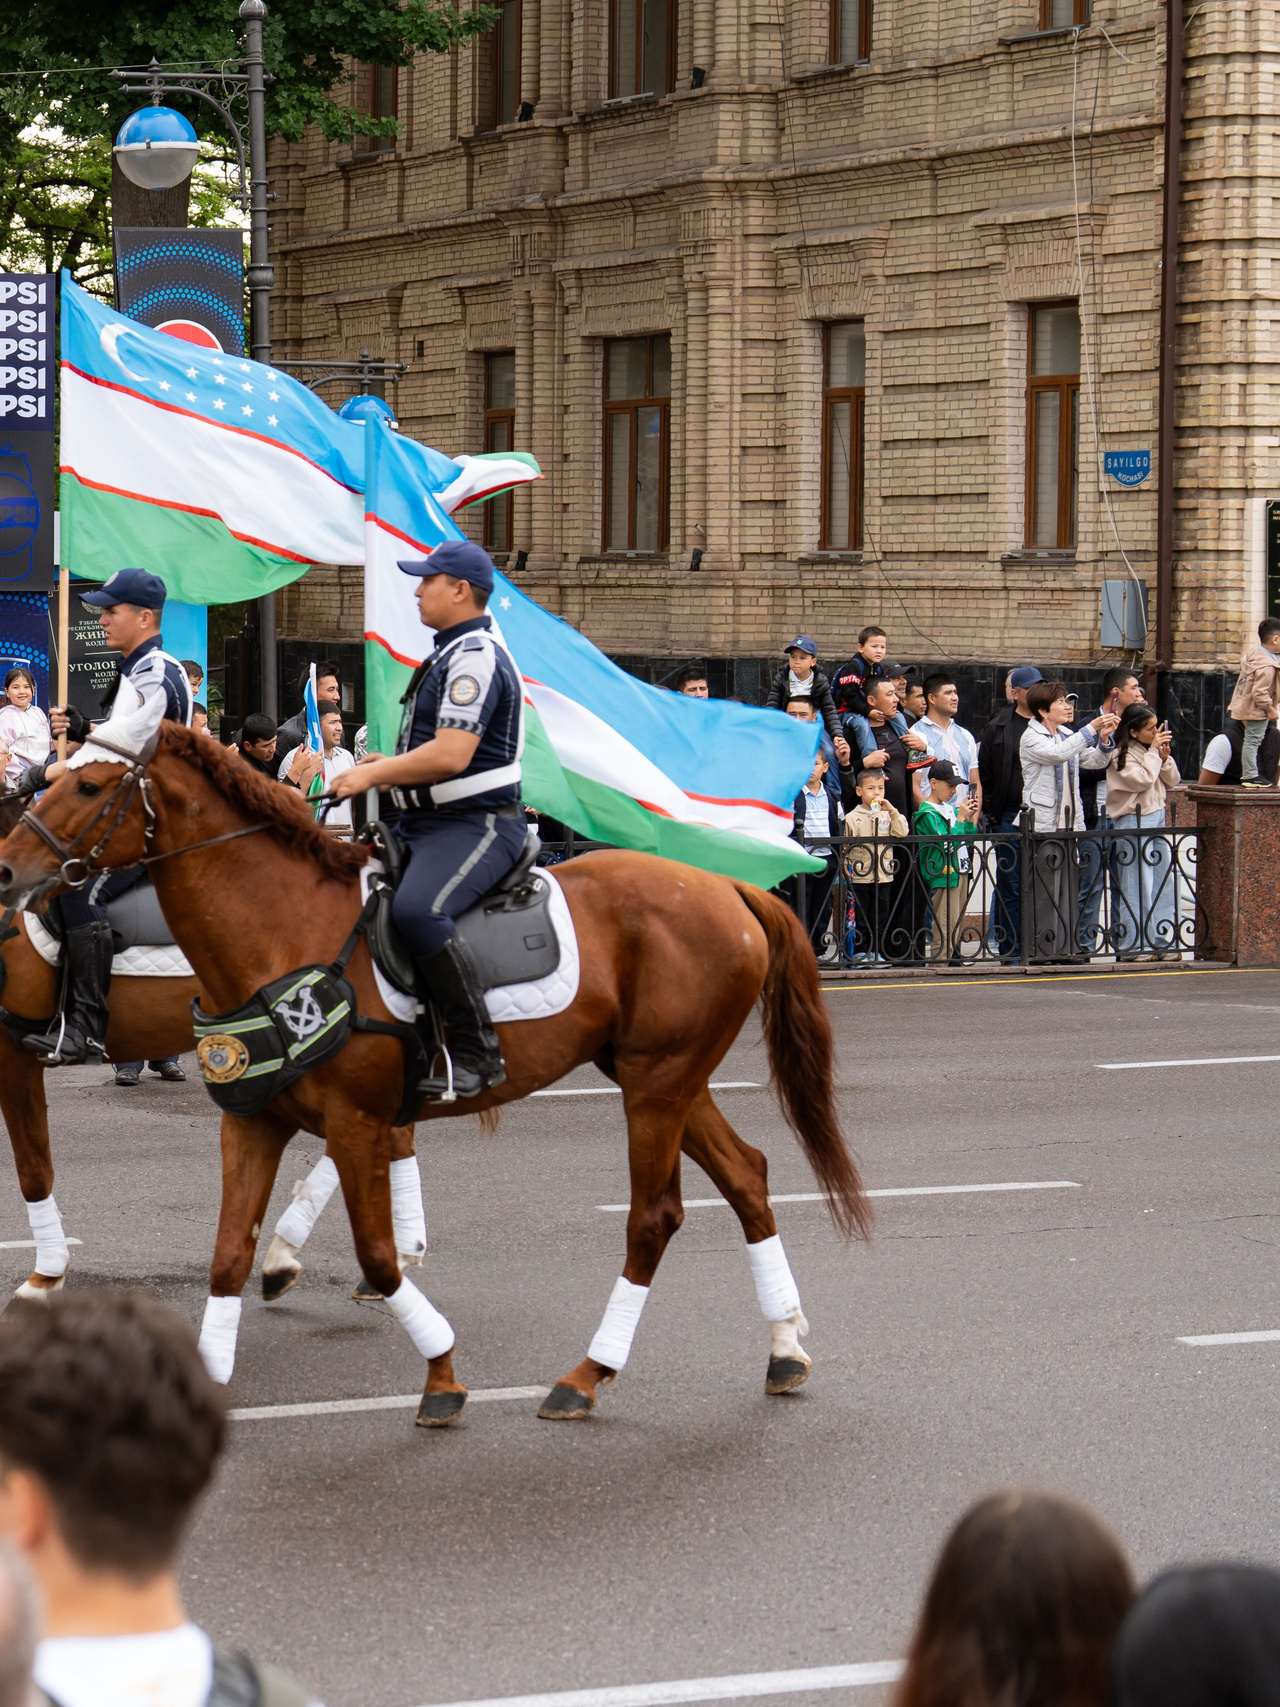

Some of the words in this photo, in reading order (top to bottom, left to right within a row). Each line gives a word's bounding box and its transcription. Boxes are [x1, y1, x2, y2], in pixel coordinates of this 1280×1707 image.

[1107, 456, 1149, 469] SAYILGO
[1117, 471, 1144, 483] KOCHASI
[74, 630, 106, 641] ЖИН
[69, 660, 117, 673] УГОЛОВ
